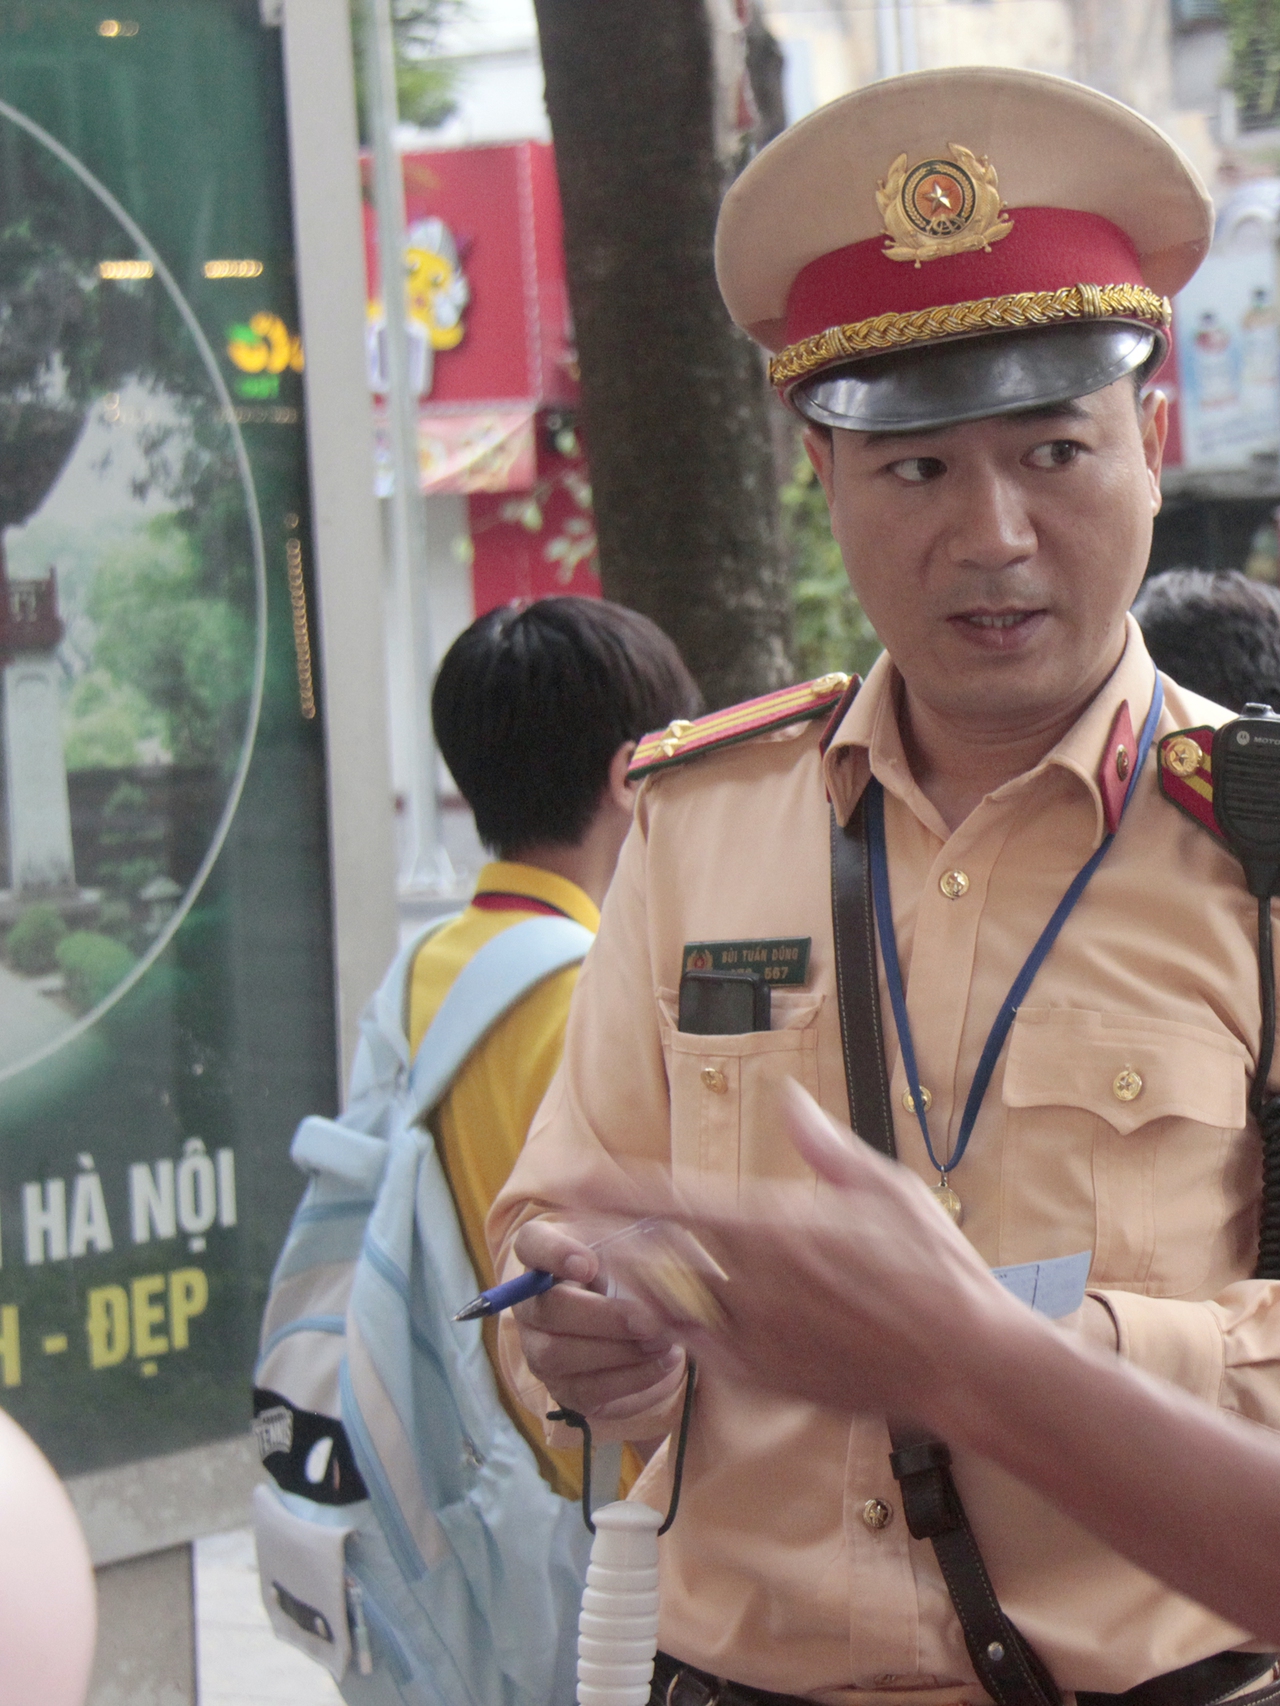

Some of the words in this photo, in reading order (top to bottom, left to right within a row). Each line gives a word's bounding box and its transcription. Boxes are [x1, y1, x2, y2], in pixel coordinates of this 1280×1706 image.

[22, 1152, 114, 1266] HÀ
[129, 1137, 237, 1253] NỘI
[86, 1267, 209, 1377] ĐẸP
